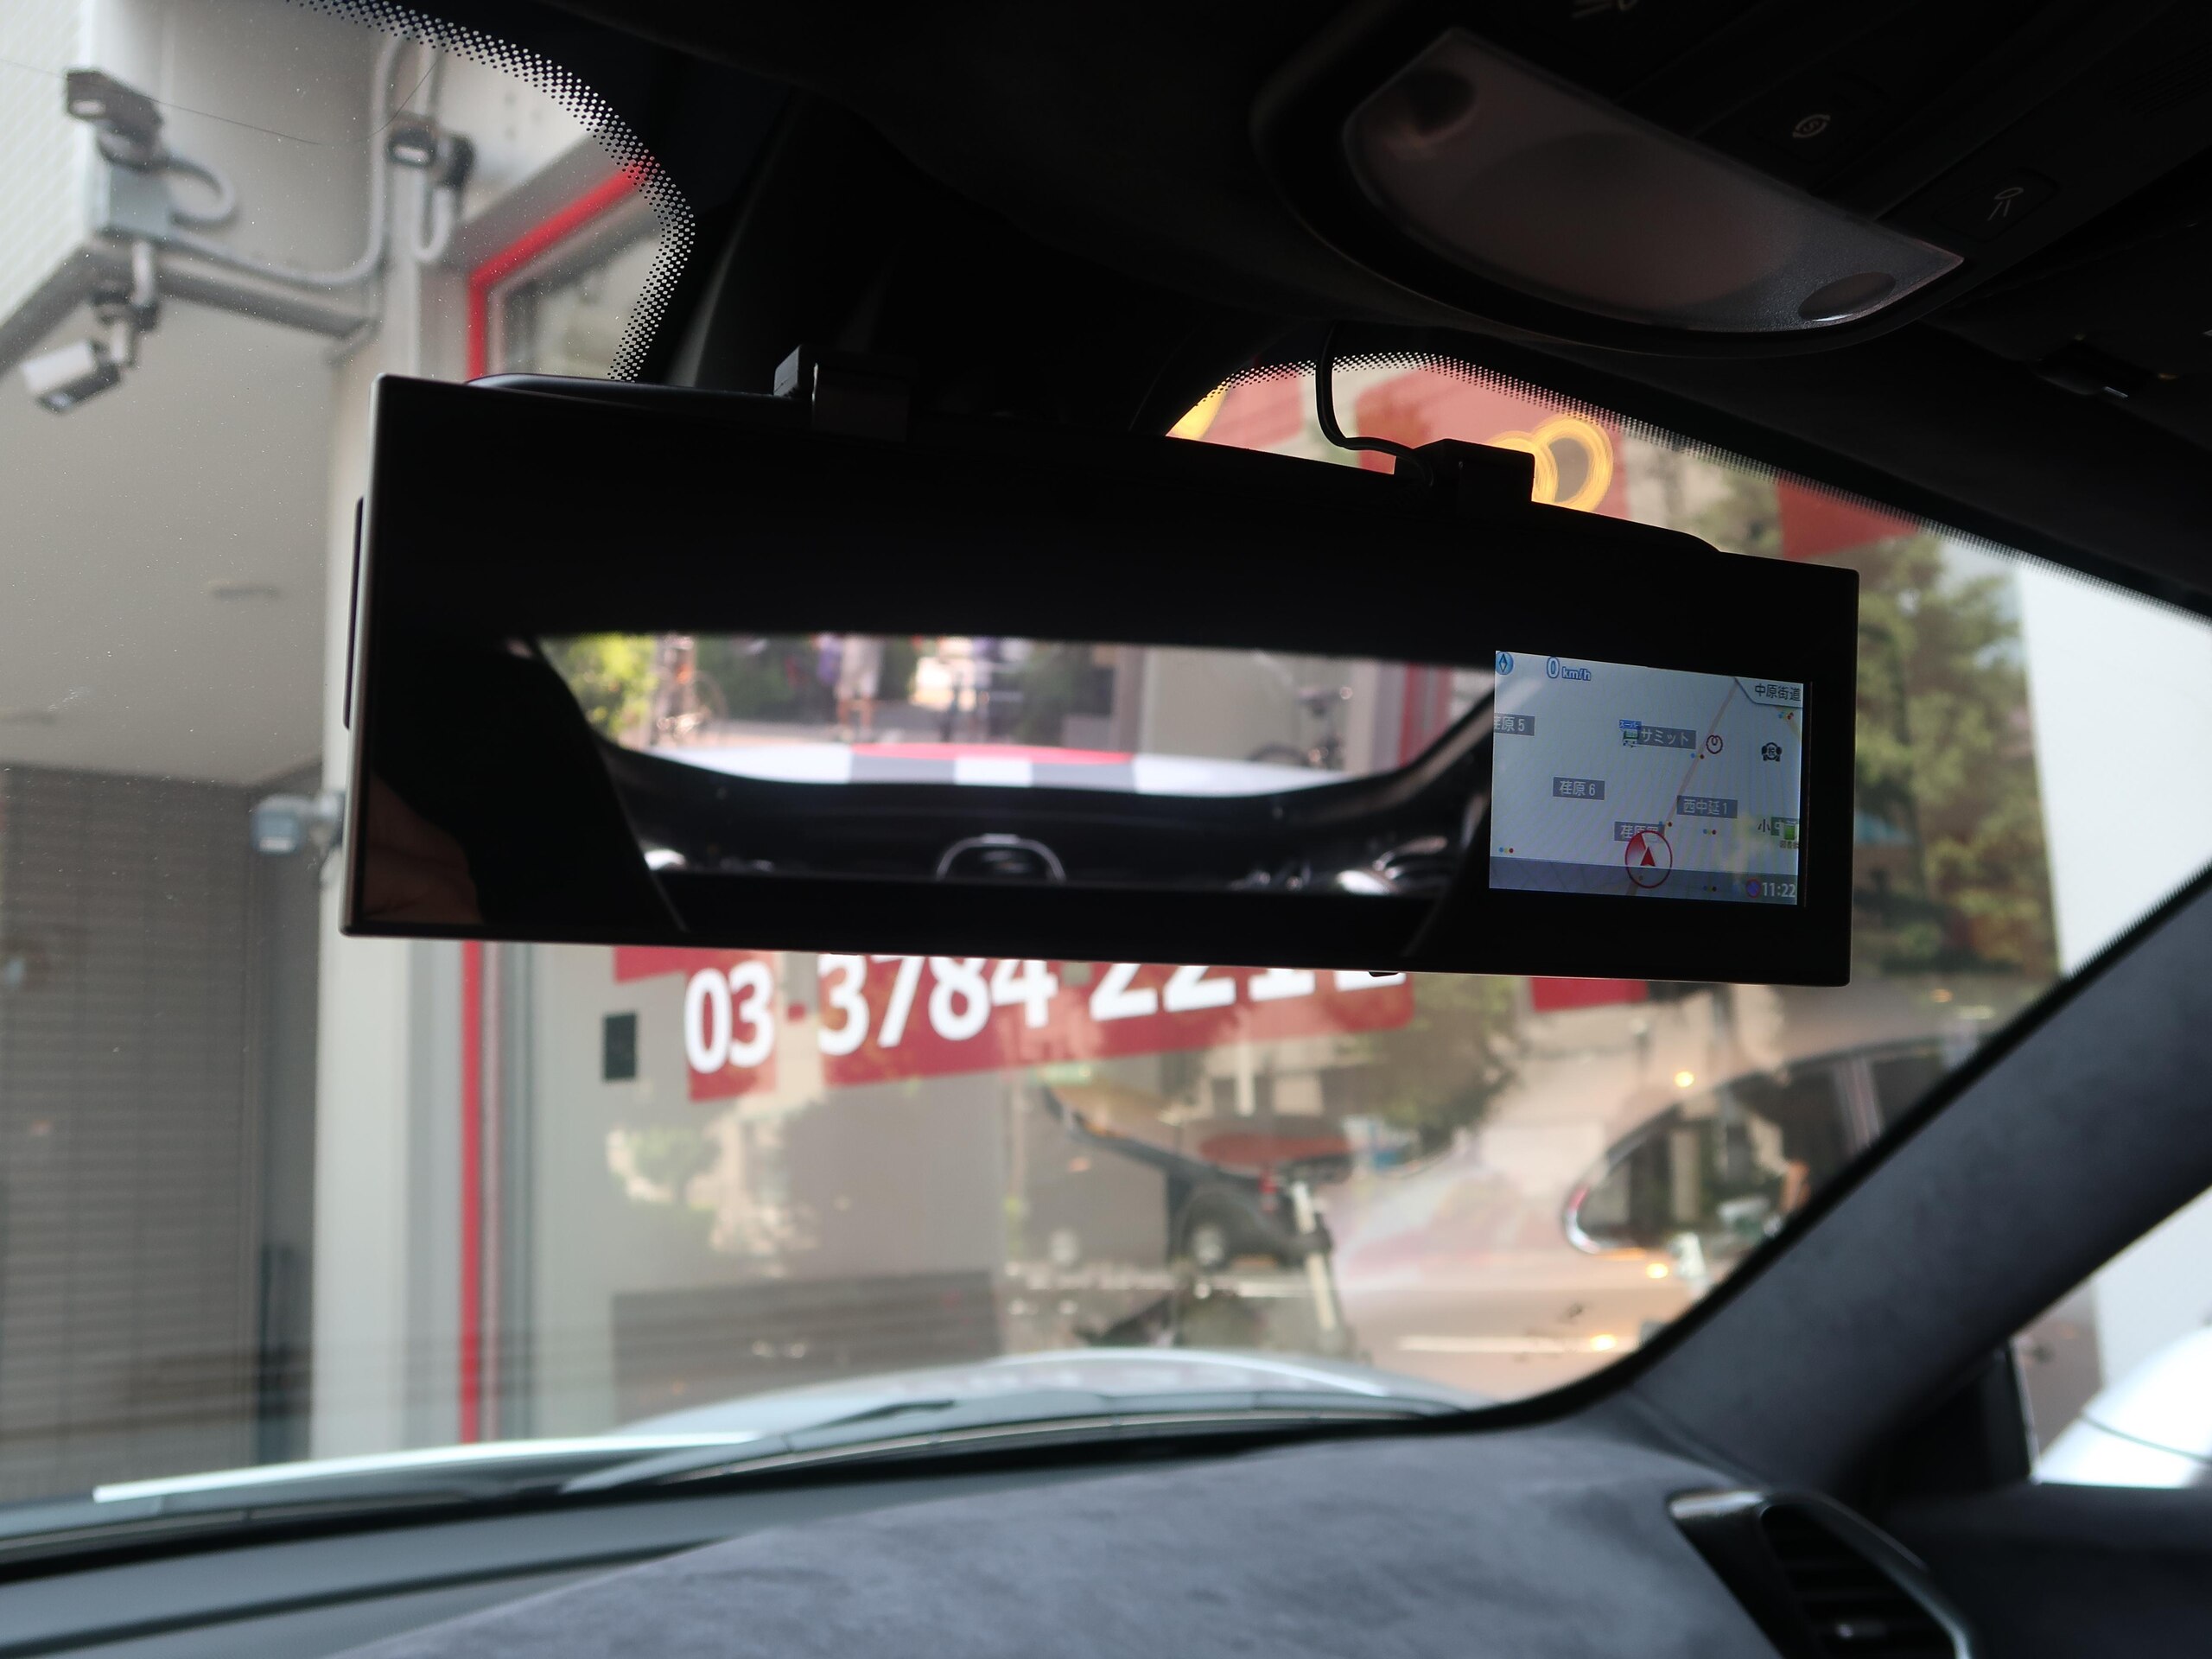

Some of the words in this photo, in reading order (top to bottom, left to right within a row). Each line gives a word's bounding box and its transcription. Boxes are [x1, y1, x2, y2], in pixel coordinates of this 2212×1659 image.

[1546, 657, 1560, 679] 0
[1562, 665, 1592, 681] km/h
[1754, 683, 1802, 702] 中原街道
[1640, 728, 1690, 746] サミット
[1762, 881, 1796, 899] 11:22
